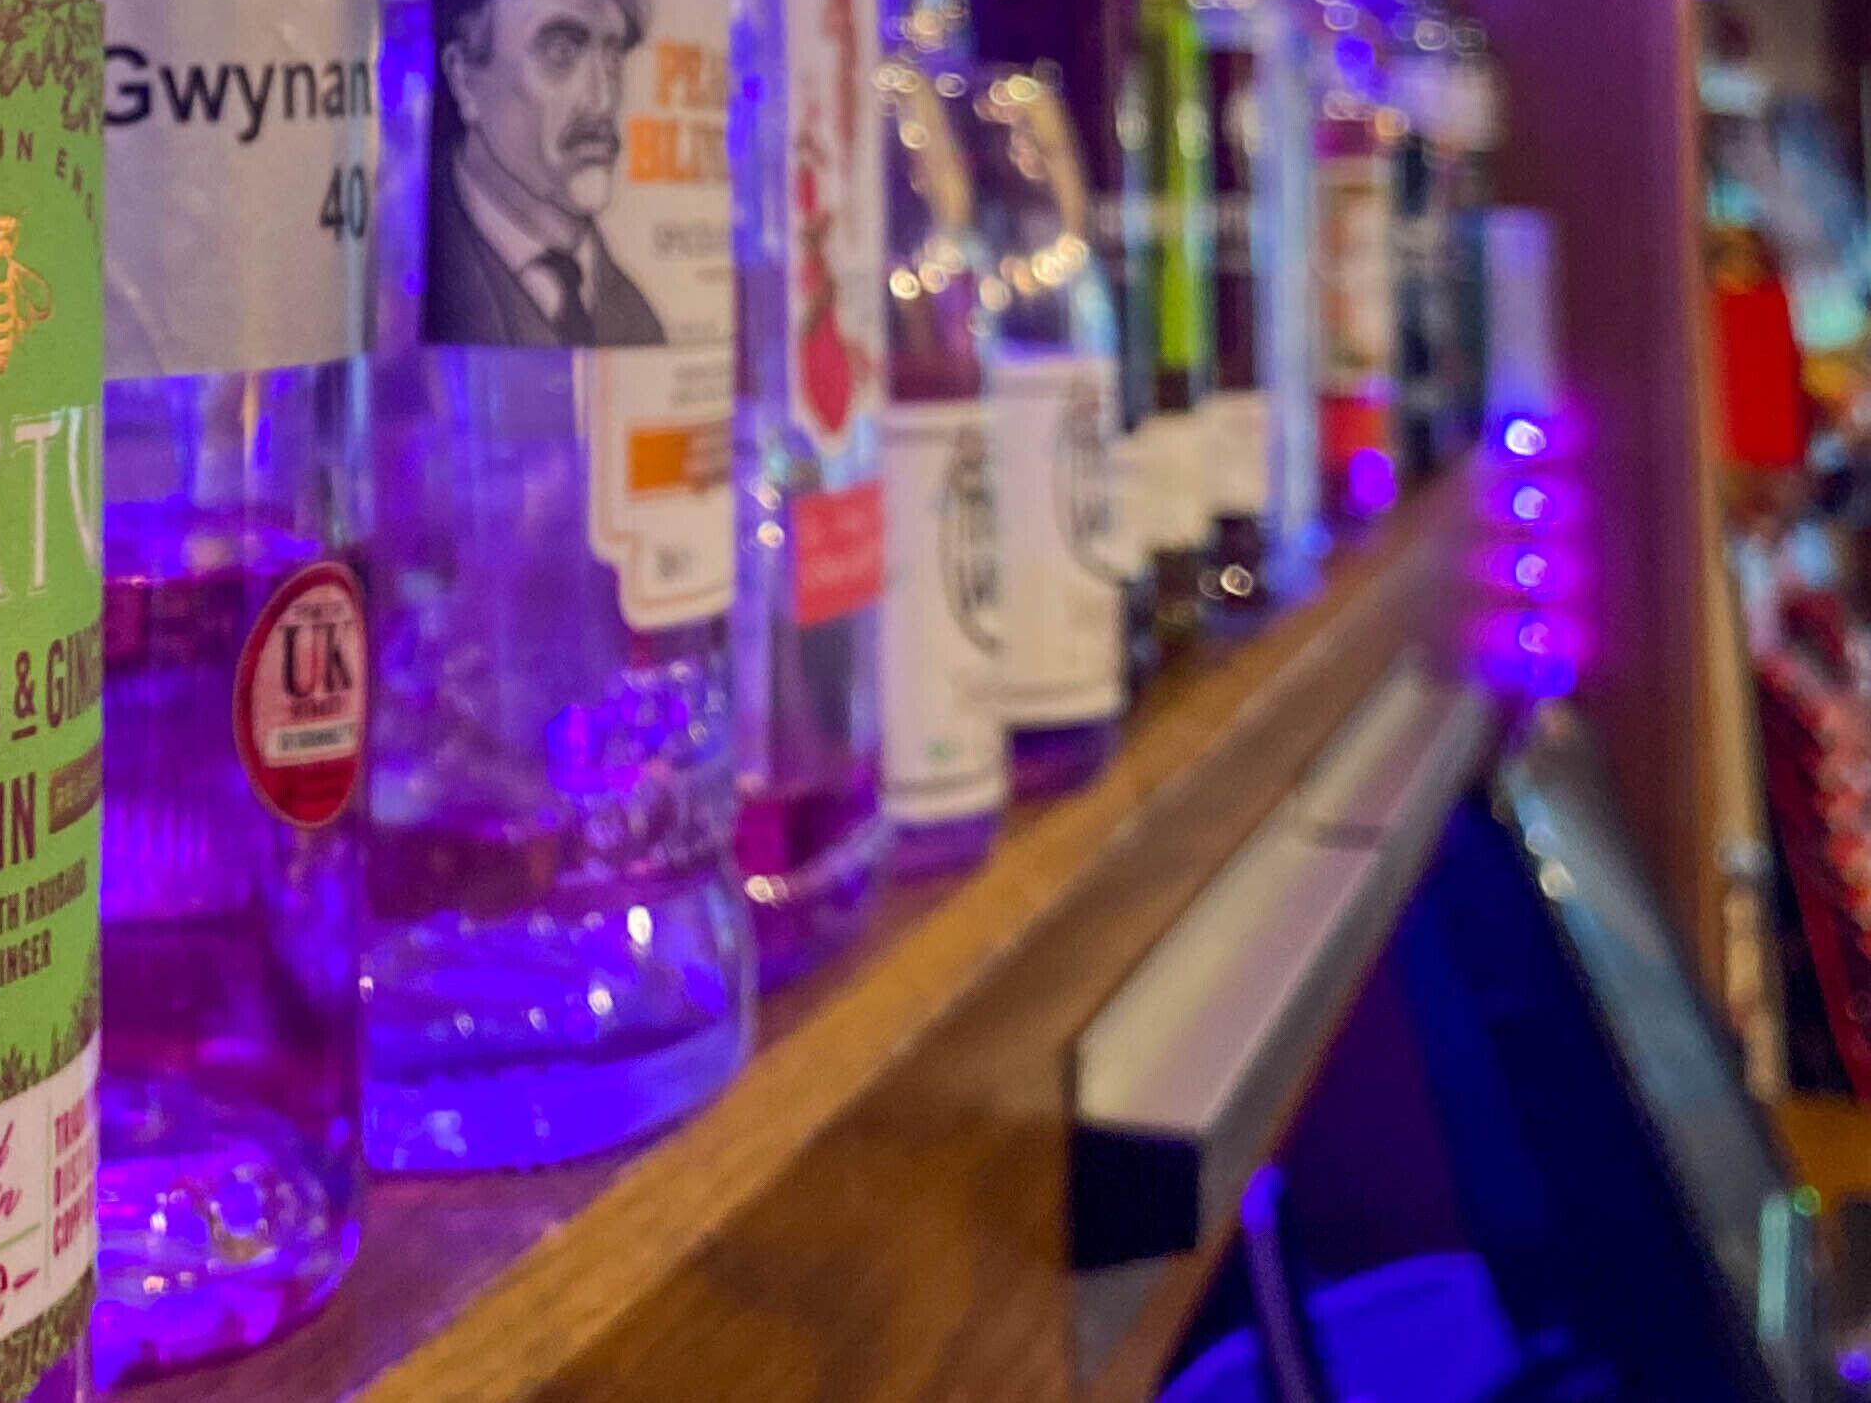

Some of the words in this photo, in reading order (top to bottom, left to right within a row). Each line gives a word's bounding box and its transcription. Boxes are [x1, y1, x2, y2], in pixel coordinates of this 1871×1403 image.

[319, 164, 368, 241] 40
[12, 650, 37, 726] &
[279, 620, 352, 698] UK
